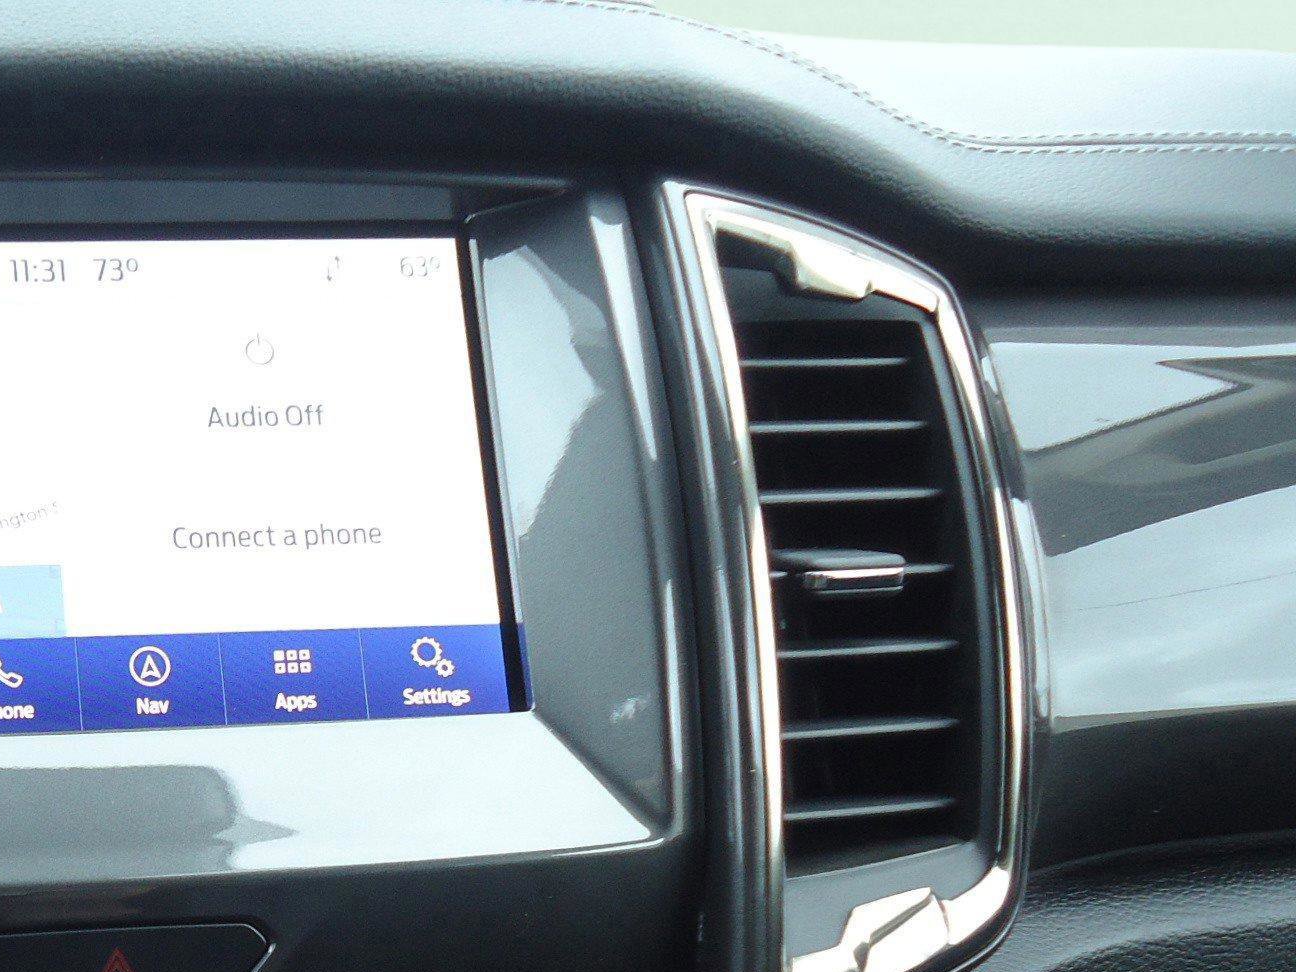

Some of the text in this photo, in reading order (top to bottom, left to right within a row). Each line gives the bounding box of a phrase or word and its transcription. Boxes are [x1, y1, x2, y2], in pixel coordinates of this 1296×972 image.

[9, 258, 67, 284] 11:31
[207, 404, 326, 430] Audio Off
[172, 523, 382, 549] Connect a phone
[136, 697, 170, 716] Nav
[275, 692, 317, 713] Apps
[403, 686, 471, 707] Settings
